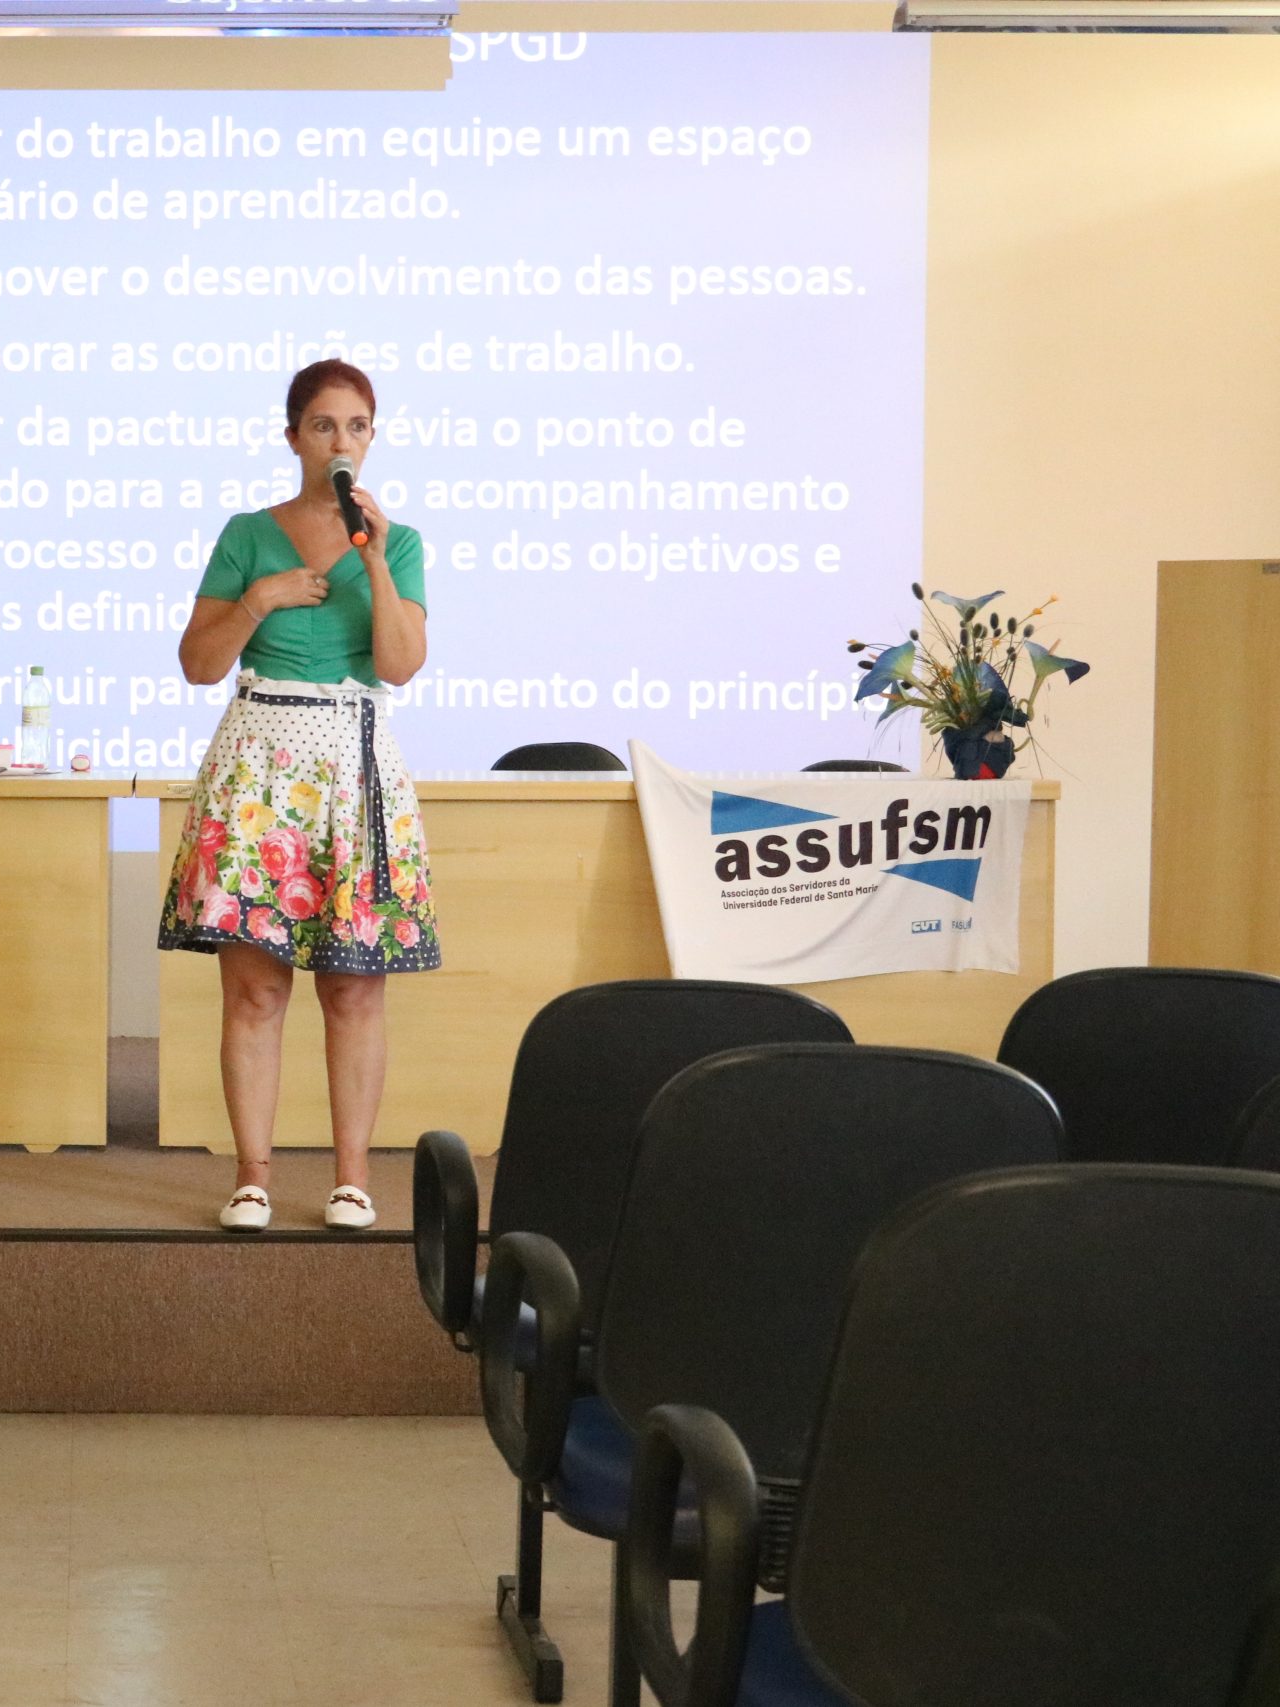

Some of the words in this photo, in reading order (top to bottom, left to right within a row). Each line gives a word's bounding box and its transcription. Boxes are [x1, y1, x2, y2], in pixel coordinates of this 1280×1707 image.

[16, 117, 75, 160] do
[86, 115, 282, 160] trabalho
[296, 126, 367, 158] em
[382, 115, 543, 167] equipe
[559, 126, 631, 157] um
[648, 125, 813, 167] espaço
[92, 177, 150, 221] de
[163, 176, 461, 230] aprendizado.
[121, 265, 150, 297] o
[163, 253, 562, 297] desenvolvimento
[575, 253, 654, 296] das
[670, 264, 867, 306] pessoas.
[111, 340, 160, 373] as
[416, 329, 475, 373] de
[485, 329, 695, 373] trabalho.
[16, 403, 71, 447] da
[87, 404, 289, 458] pactuaçã
[370, 403, 478, 449] évia
[492, 416, 522, 448] o
[537, 410, 675, 457] ponto
[689, 405, 747, 449] de
[66, 477, 165, 519] para
[177, 477, 205, 509] a
[218, 465, 295, 511] açã
[379, 479, 408, 510] o
[424, 469, 851, 520] acompanhamento
[451, 540, 478, 572] e
[492, 529, 573, 572] dos
[588, 529, 801, 582] objetivos
[815, 543, 841, 574] e
[36, 590, 193, 633] definid
[386, 668, 599, 718] primento
[612, 667, 672, 711] do
[714, 798, 992, 882] assufsm
[721, 887, 770, 899] Associação
[771, 885, 788, 895] dos
[789, 879, 838, 892] Servidores
[839, 876, 851, 887] da
[722, 898, 778, 910] Universidade
[780, 893, 813, 906] Federal
[814, 891, 825, 902] de
[827, 889, 854, 900] Santa
[912, 920, 939, 933] CUT
